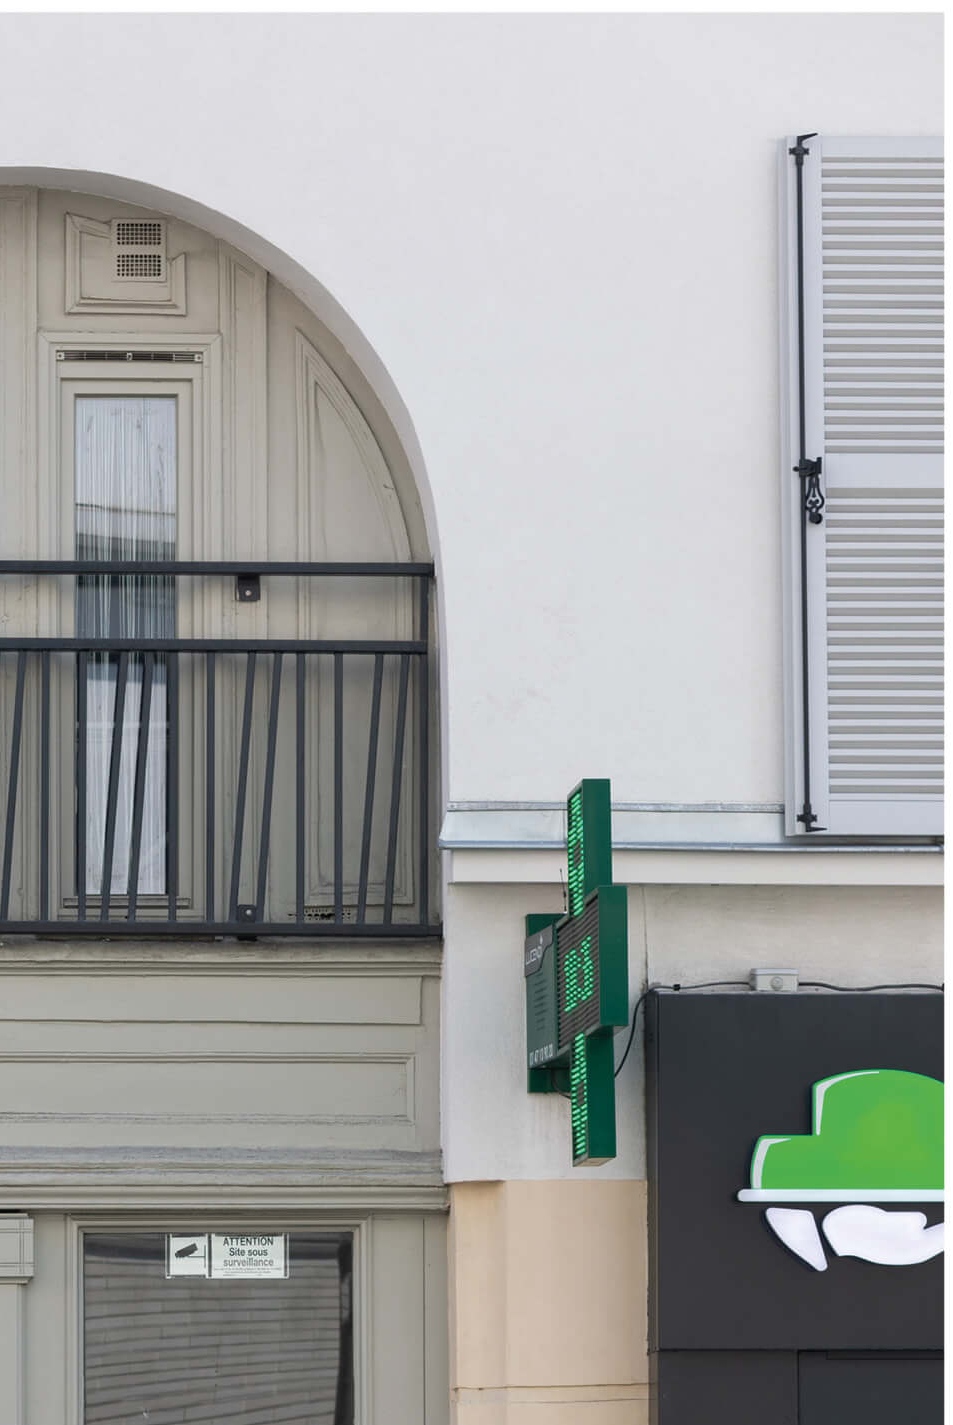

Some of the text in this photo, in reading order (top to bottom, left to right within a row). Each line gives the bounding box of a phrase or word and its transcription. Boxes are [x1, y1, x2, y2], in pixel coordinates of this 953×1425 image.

[223, 1237, 274, 1246] ATTENTION
[229, 1247, 246, 1256] Site
[223, 1257, 274, 1267] surveillance
